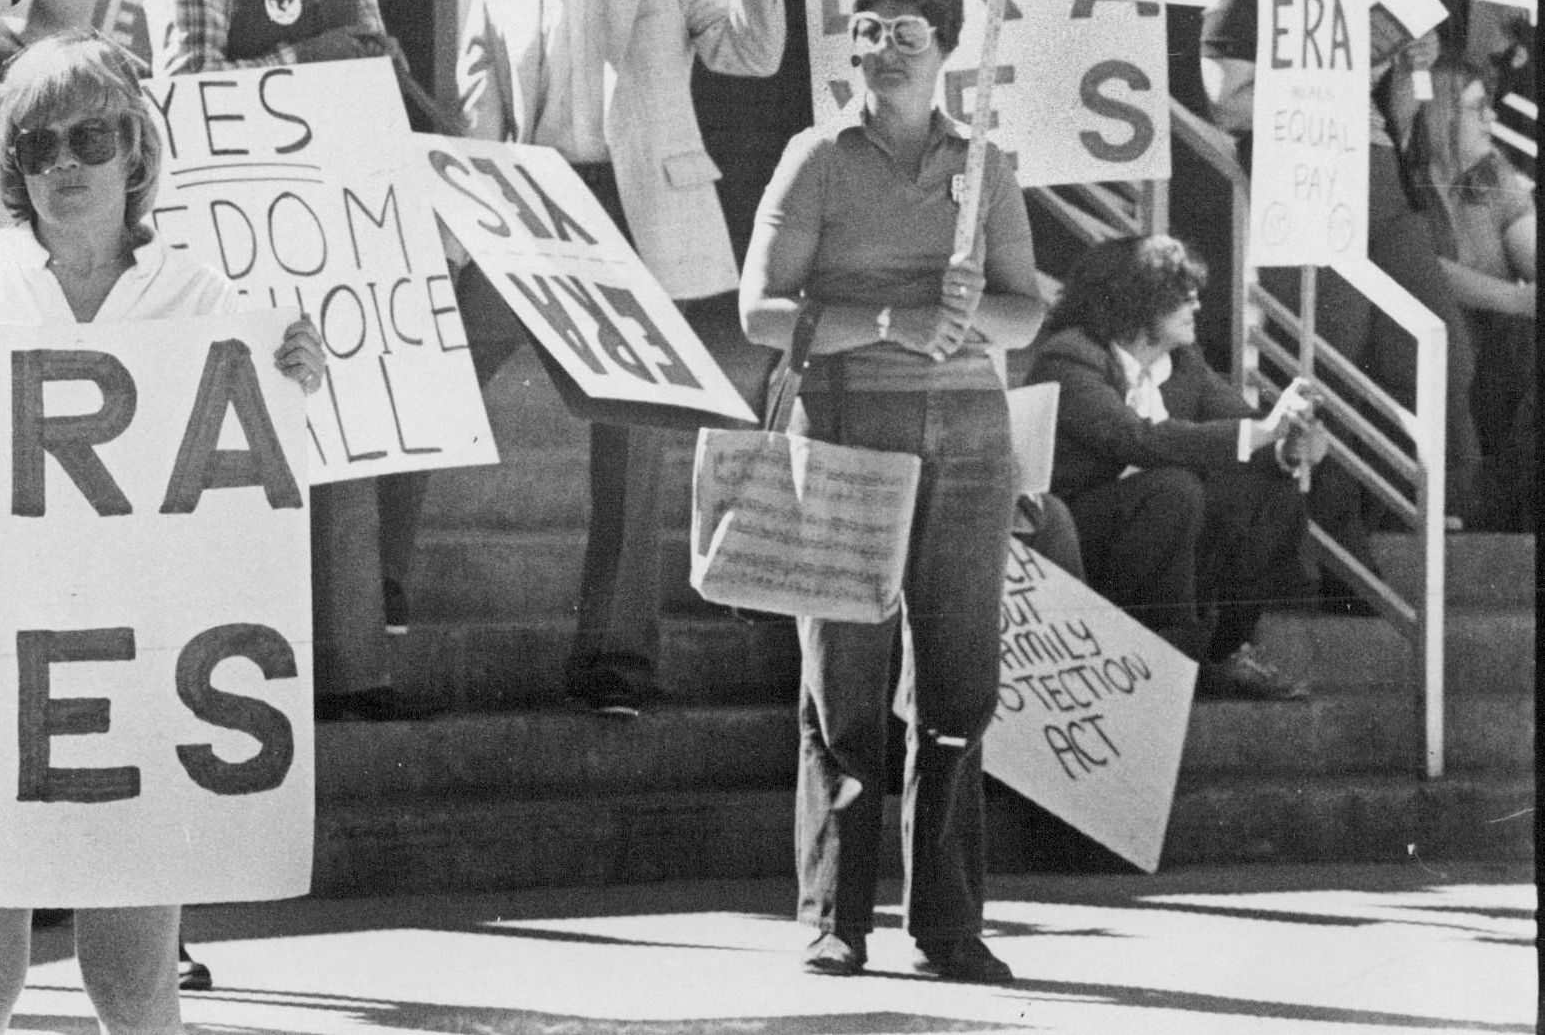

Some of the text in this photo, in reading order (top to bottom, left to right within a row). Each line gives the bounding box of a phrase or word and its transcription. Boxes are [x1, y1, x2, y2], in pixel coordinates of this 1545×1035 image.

[143, 68, 314, 162] YES
[1273, 108, 1357, 153] EQUAL
[1293, 162, 1338, 206] PAY
[1043, 714, 1120, 781] ACT
